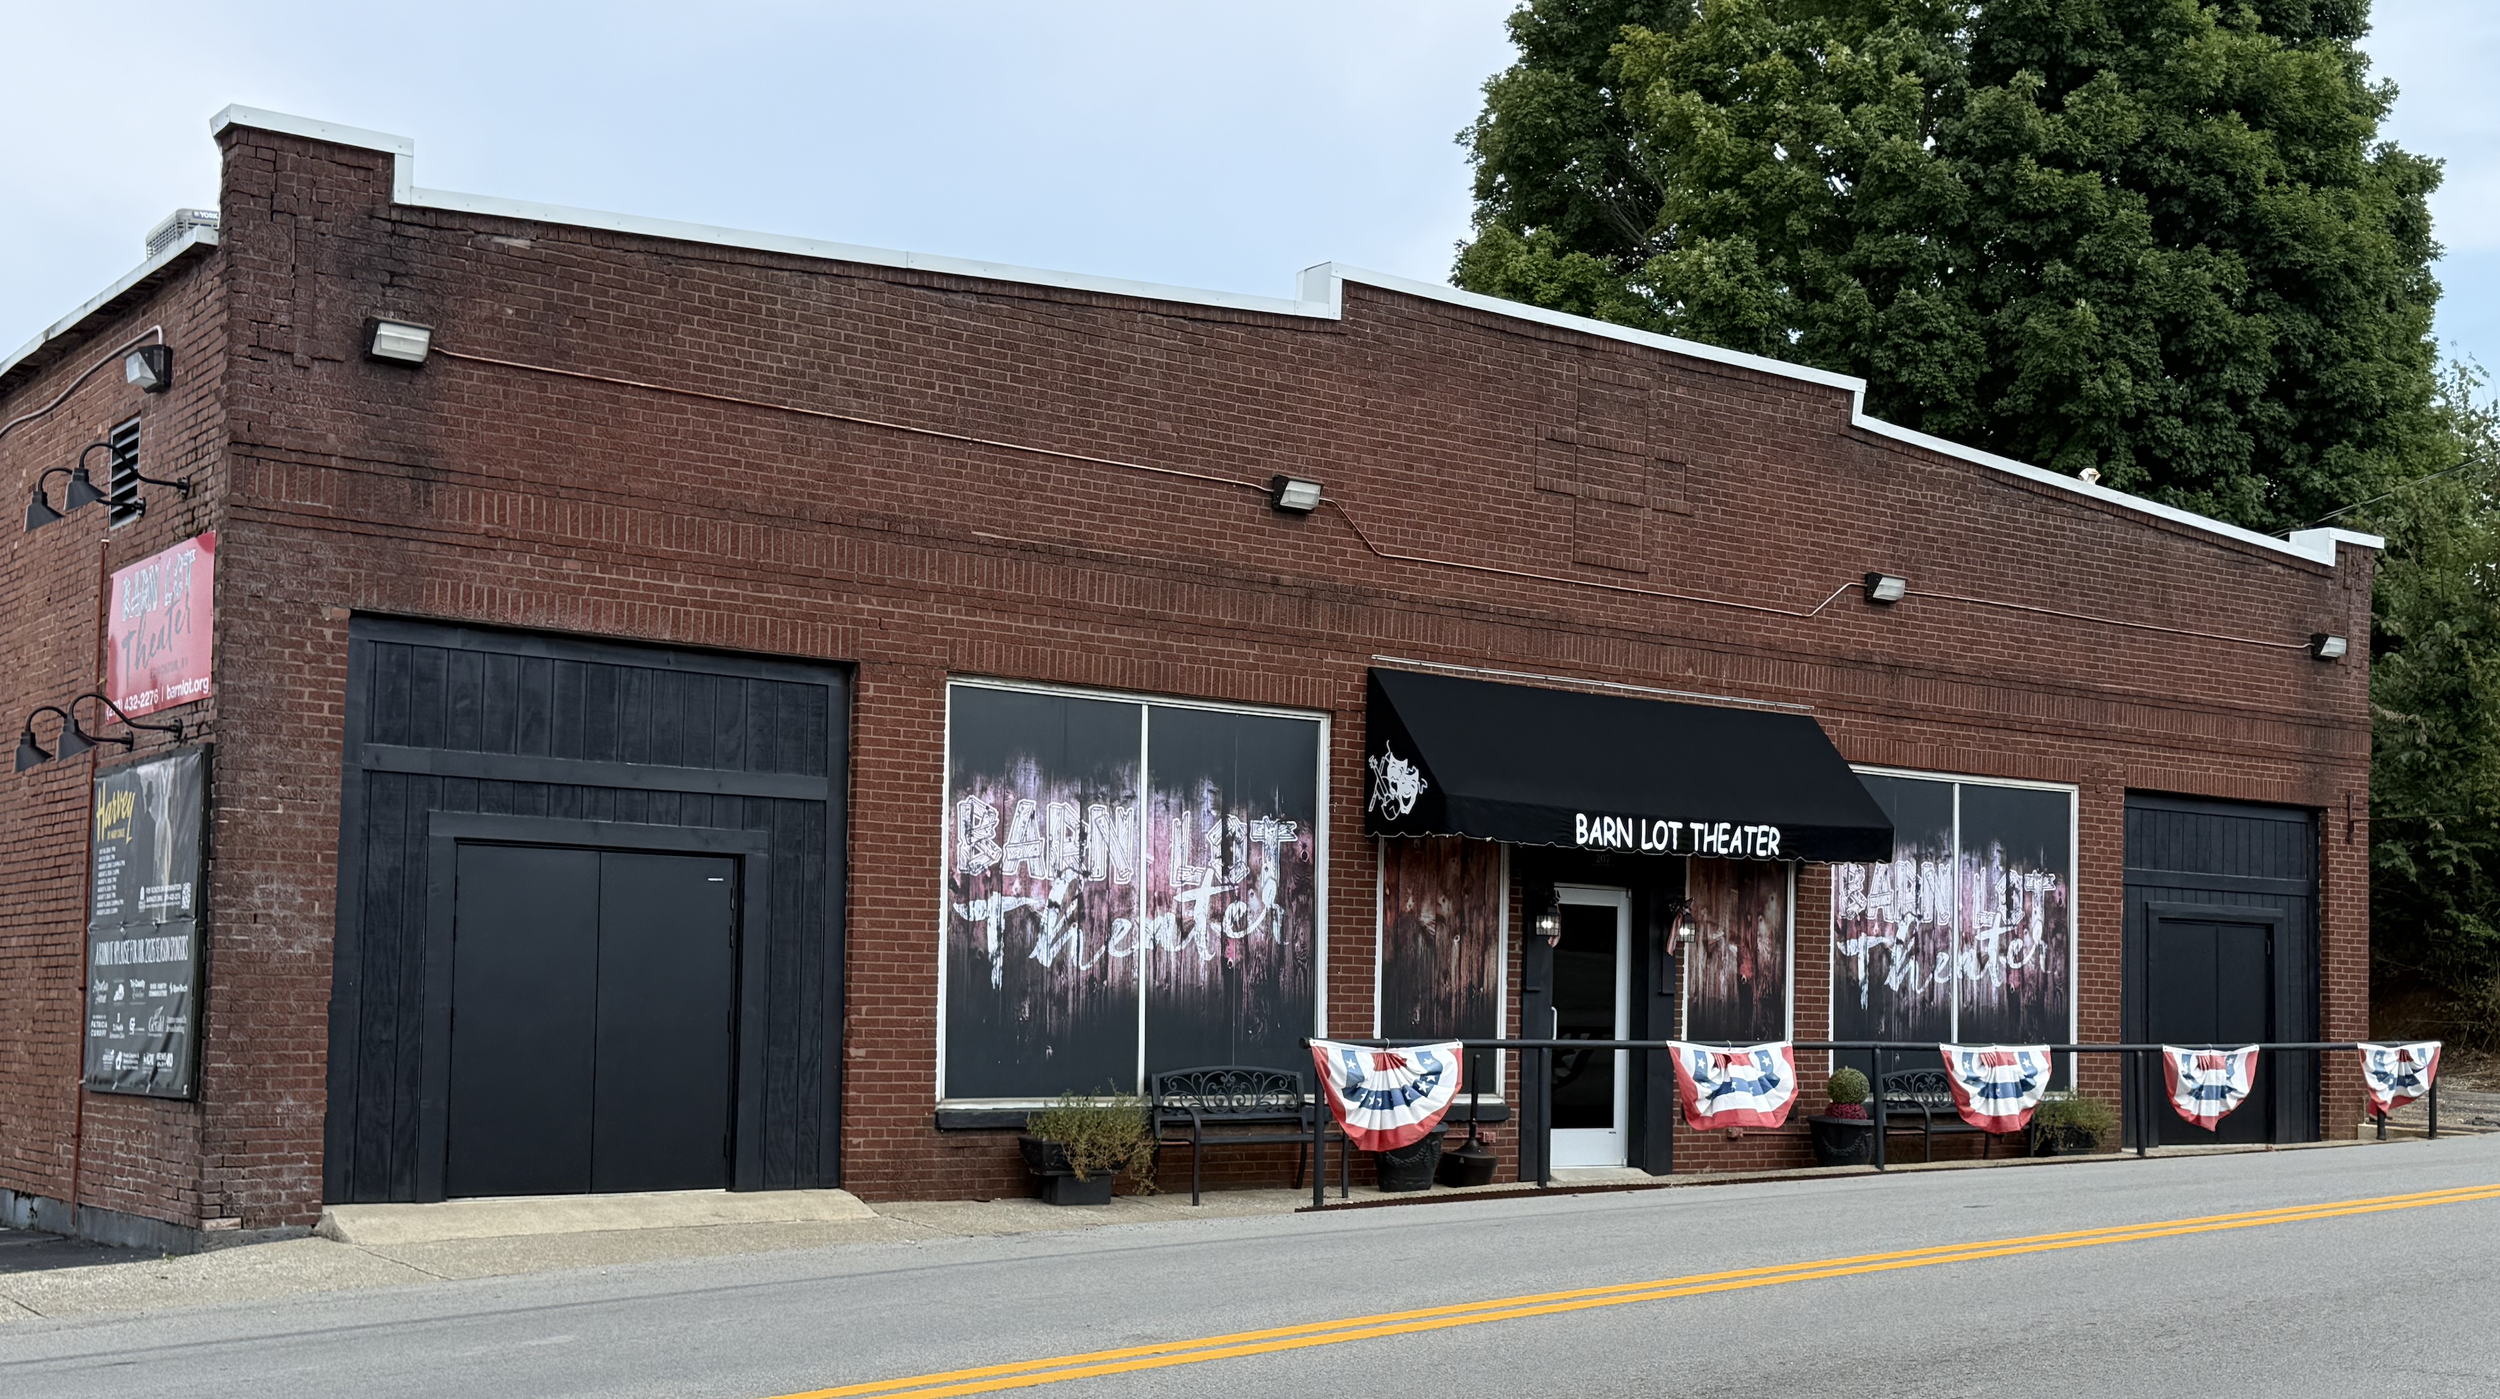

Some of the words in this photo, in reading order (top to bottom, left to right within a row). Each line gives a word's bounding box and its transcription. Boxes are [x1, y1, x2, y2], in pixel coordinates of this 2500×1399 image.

[121, 563, 161, 621] BARN
[164, 548, 197, 607] LOT
[121, 591, 191, 689] Theater
[124, 688, 159, 711] 432-2276
[166, 676, 210, 700] barnlot.org
[96, 780, 136, 845] Harvey
[956, 794, 1135, 884] BARN
[1170, 810, 1298, 886] LOT
[1575, 812, 1634, 848] BARN
[1640, 818, 1684, 851] LOT
[1689, 822, 1780, 857] THEATER
[1596, 854, 1610, 864] 207
[1838, 860, 1952, 925] BARN
[1973, 867, 2056, 928] LOT
[953, 868, 1290, 990] Theater
[1837, 911, 2051, 1010] Theater
